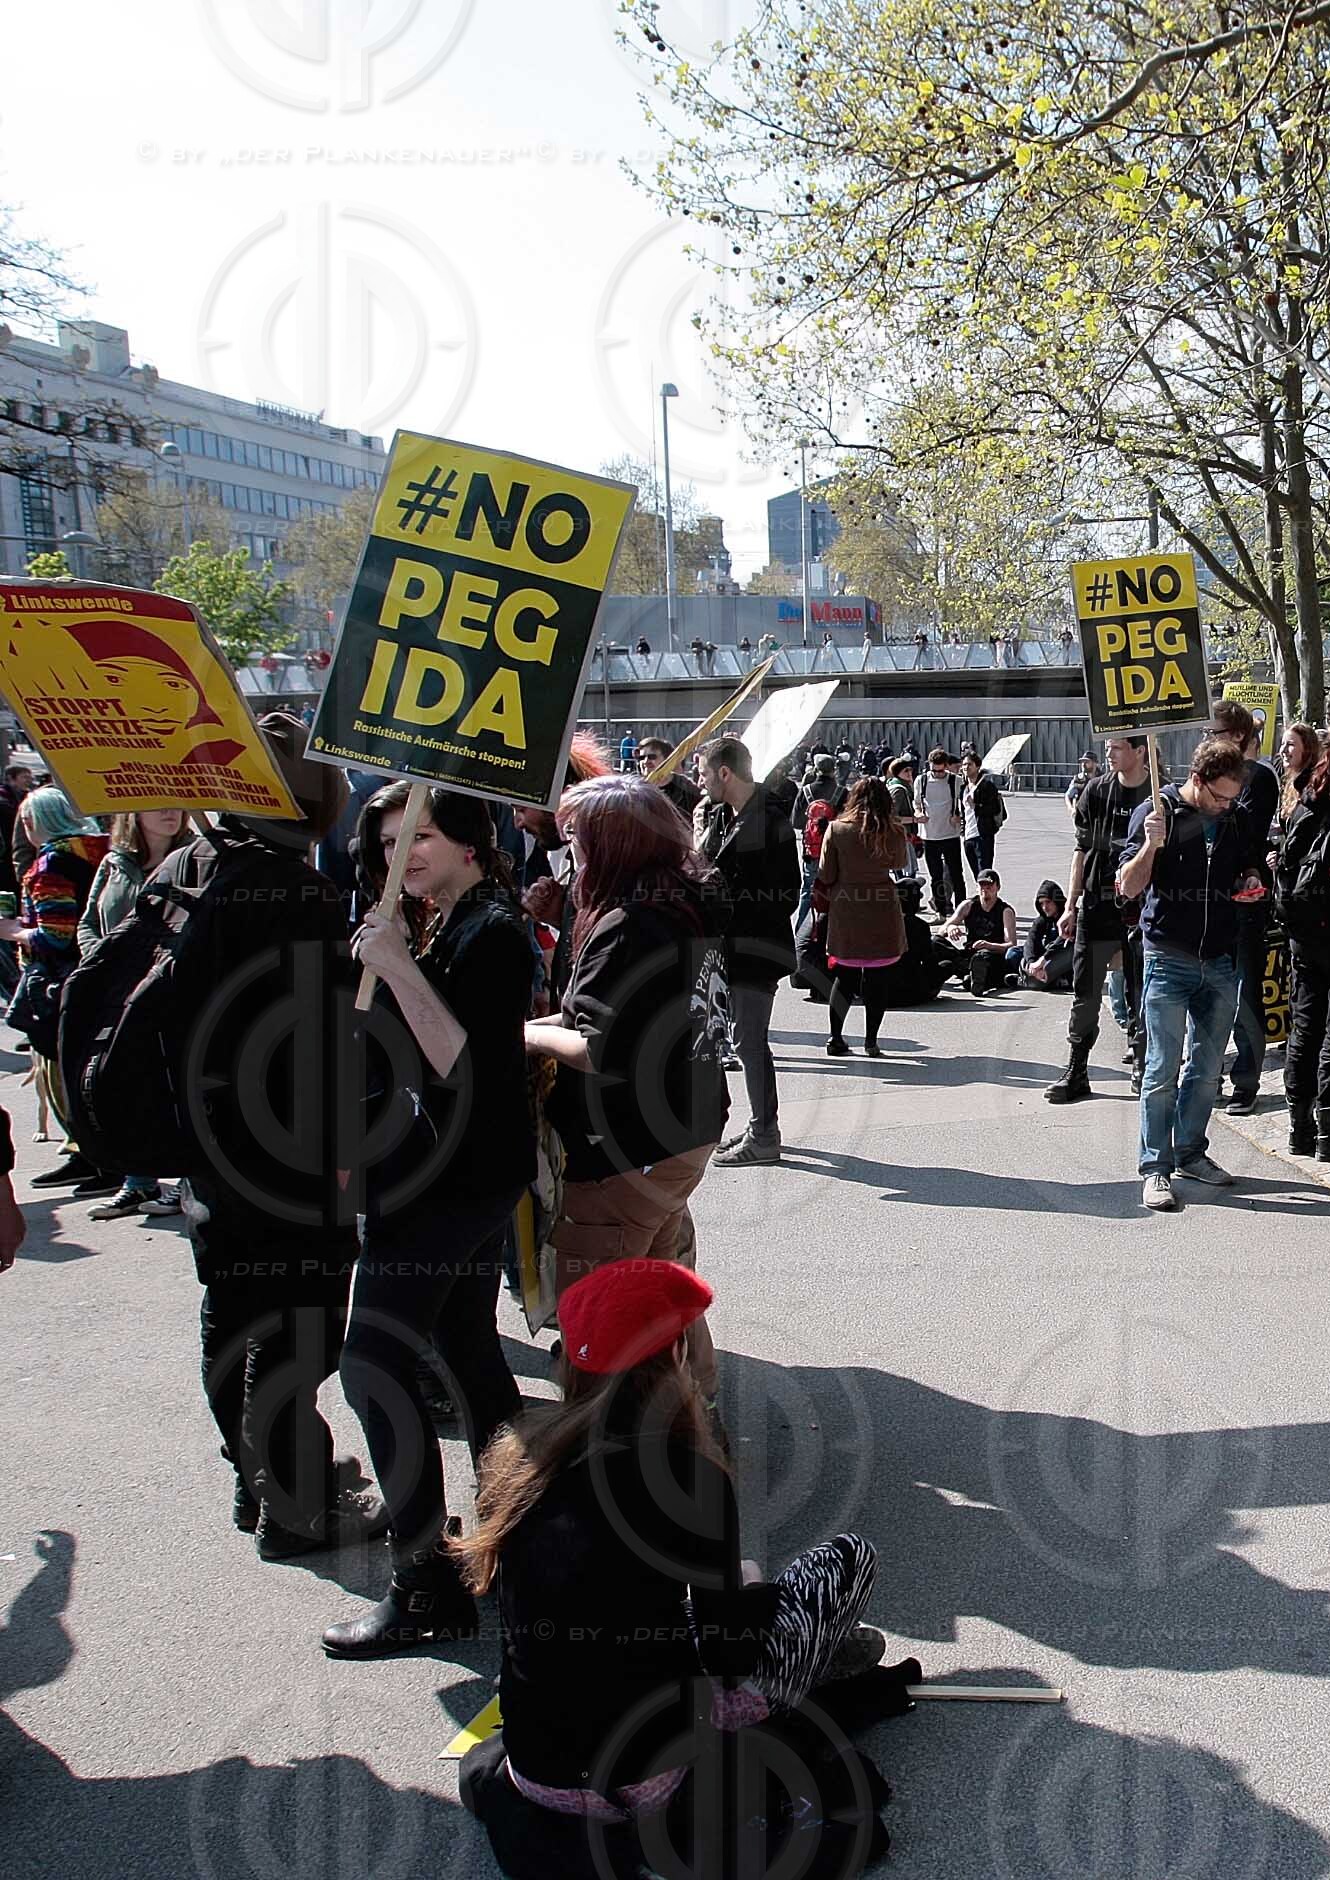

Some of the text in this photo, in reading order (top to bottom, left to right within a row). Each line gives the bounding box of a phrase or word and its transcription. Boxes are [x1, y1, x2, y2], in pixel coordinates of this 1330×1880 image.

[396, 465, 592, 565] #NO
[10, 594, 134, 612] Linkswende
[1086, 564, 1182, 612] #NO
[378, 557, 560, 666] PEG
[1096, 617, 1188, 663] PEG
[359, 639, 526, 749] IDA
[1103, 660, 1192, 707] IDA
[24, 698, 128, 716] STOPPT
[34, 718, 149, 735] DIE HETZE
[40, 736, 166, 750] GEGEN MUSLIME
[324, 743, 392, 767] Linkswende
[352, 719, 526, 770] Rassistische Aufmärsche stoppen!
[155, 775, 193, 787] OLAN
[198, 776, 218, 787] BU
